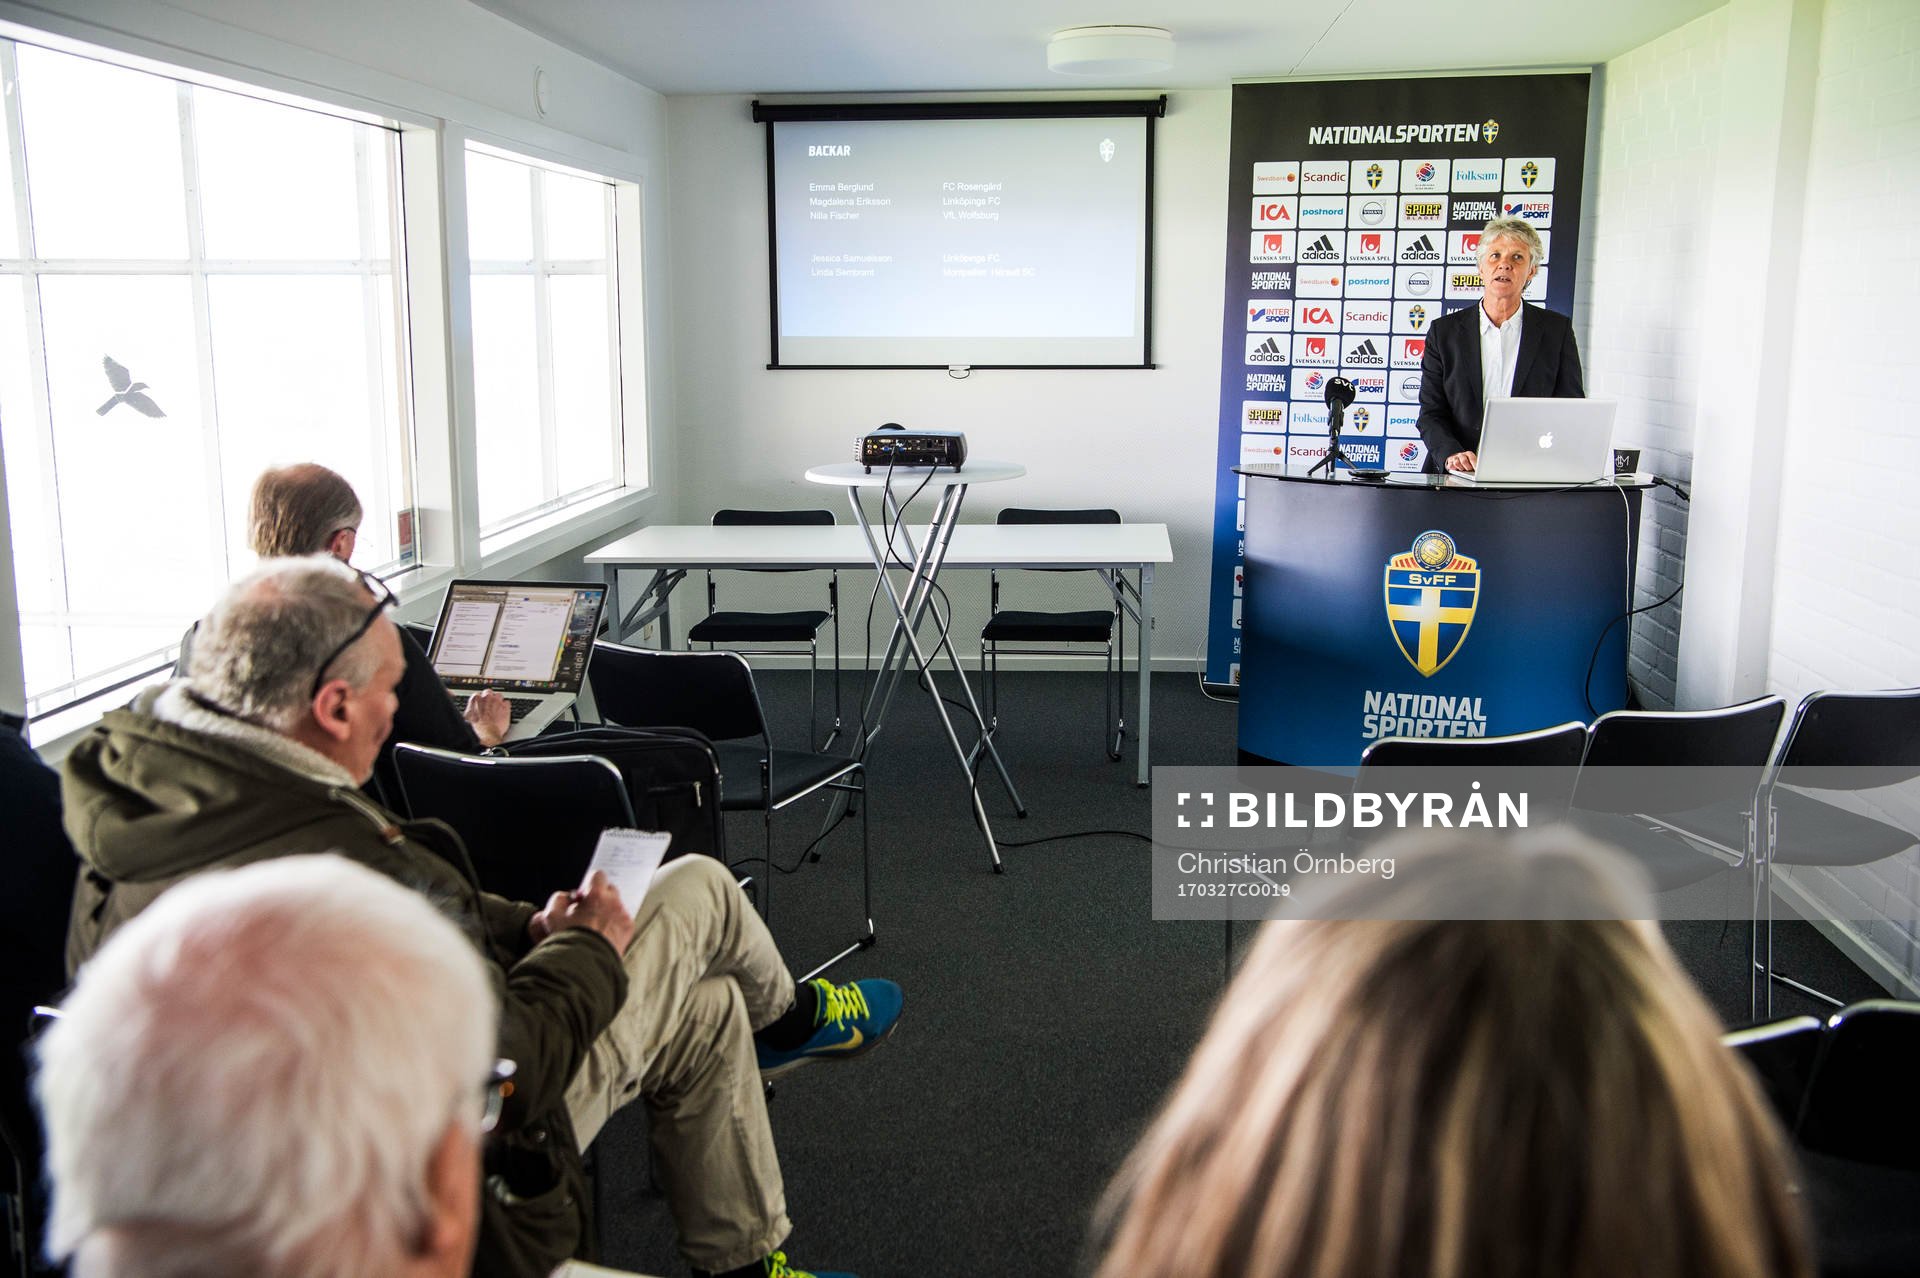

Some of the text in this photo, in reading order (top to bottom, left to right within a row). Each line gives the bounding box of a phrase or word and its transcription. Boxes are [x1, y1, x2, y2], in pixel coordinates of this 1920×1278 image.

[1309, 124, 1480, 145] NATIONALSPORTEN
[808, 145, 851, 157] BACKAR
[1303, 172, 1346, 182] Scandic
[1456, 170, 1498, 181] Folksam
[809, 182, 874, 193] Emma Berglund
[943, 182, 955, 191] FC
[988, 196, 1001, 206] FC
[1453, 201, 1496, 211] NATIONAL
[1302, 208, 1344, 216] postnord
[1405, 203, 1442, 216] SPORT
[1523, 203, 1549, 211] INTER
[1260, 204, 1290, 221] ICA
[1452, 210, 1497, 221] SPORTEN
[1302, 250, 1340, 260] adidas
[1401, 250, 1440, 260] adidas
[1251, 271, 1291, 281] NATIONAL
[1251, 280, 1291, 290] SPORTEN
[1348, 278, 1389, 286] postnord
[1266, 308, 1289, 316] INTER
[1303, 307, 1334, 324] ICA
[1345, 311, 1388, 322] Scandic
[1265, 315, 1289, 323] SPORT
[1249, 353, 1286, 362] adidas
[1346, 355, 1384, 364] adidas
[1246, 373, 1286, 383] NATIONAL
[1360, 378, 1384, 386] INTER
[1246, 382, 1286, 392] SPORTEN
[1248, 409, 1282, 422] SPORT
[1390, 417, 1416, 425] postn
[1290, 447, 1328, 457] Scandi
[1339, 443, 1380, 454] NATIONAL
[1339, 453, 1380, 463] PORTEN
[1408, 573, 1457, 586] SvFF
[1363, 690, 1487, 721] NATIONAL
[1362, 714, 1487, 739] SPORTEN
